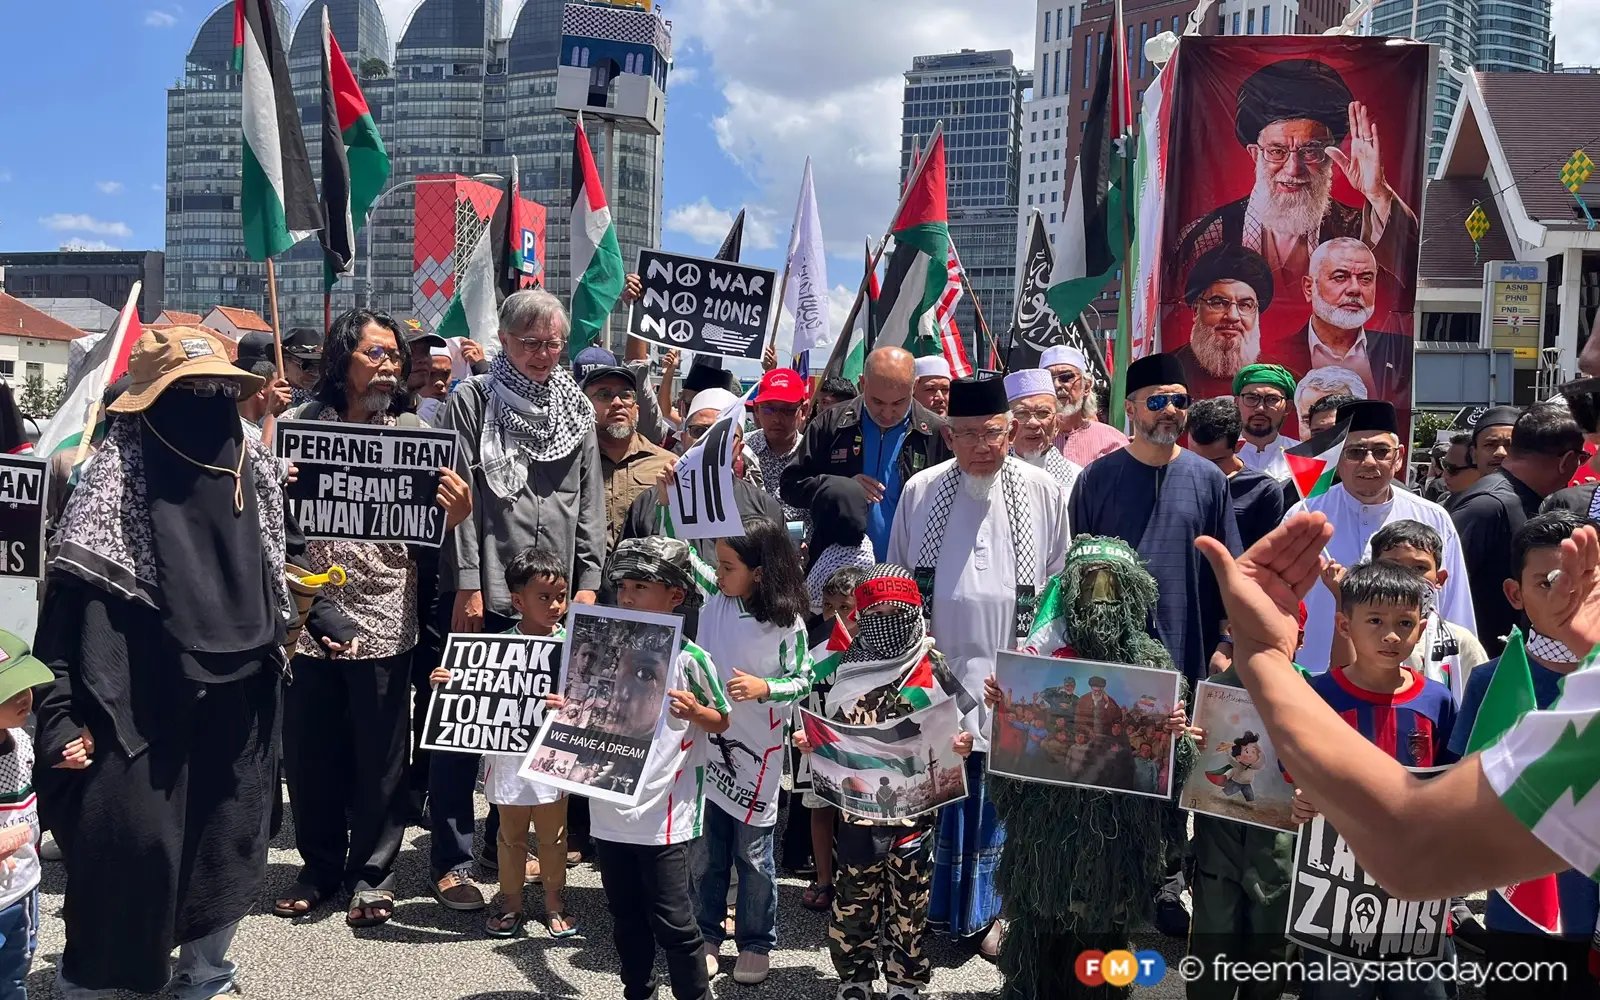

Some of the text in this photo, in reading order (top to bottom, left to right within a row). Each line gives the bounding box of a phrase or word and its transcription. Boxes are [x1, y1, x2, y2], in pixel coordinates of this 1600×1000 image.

[523, 232, 534, 256] P
[647, 258, 765, 296] NO WAR
[1501, 266, 1538, 280] PNB
[643, 287, 763, 327] NO ZIONIS
[640, 314, 694, 343] NO
[285, 433, 450, 469] PERANG IRAN
[318, 471, 413, 503] PERANG
[370, 503, 439, 539] ZIONIS
[453, 641, 556, 672] TOLAK
[445, 668, 551, 697] PERANG
[439, 694, 548, 727] TOLAK
[434, 722, 530, 752] ZIONIS
[550, 730, 645, 759] WE HAVE A DREAM
[707, 761, 735, 788] RUN
